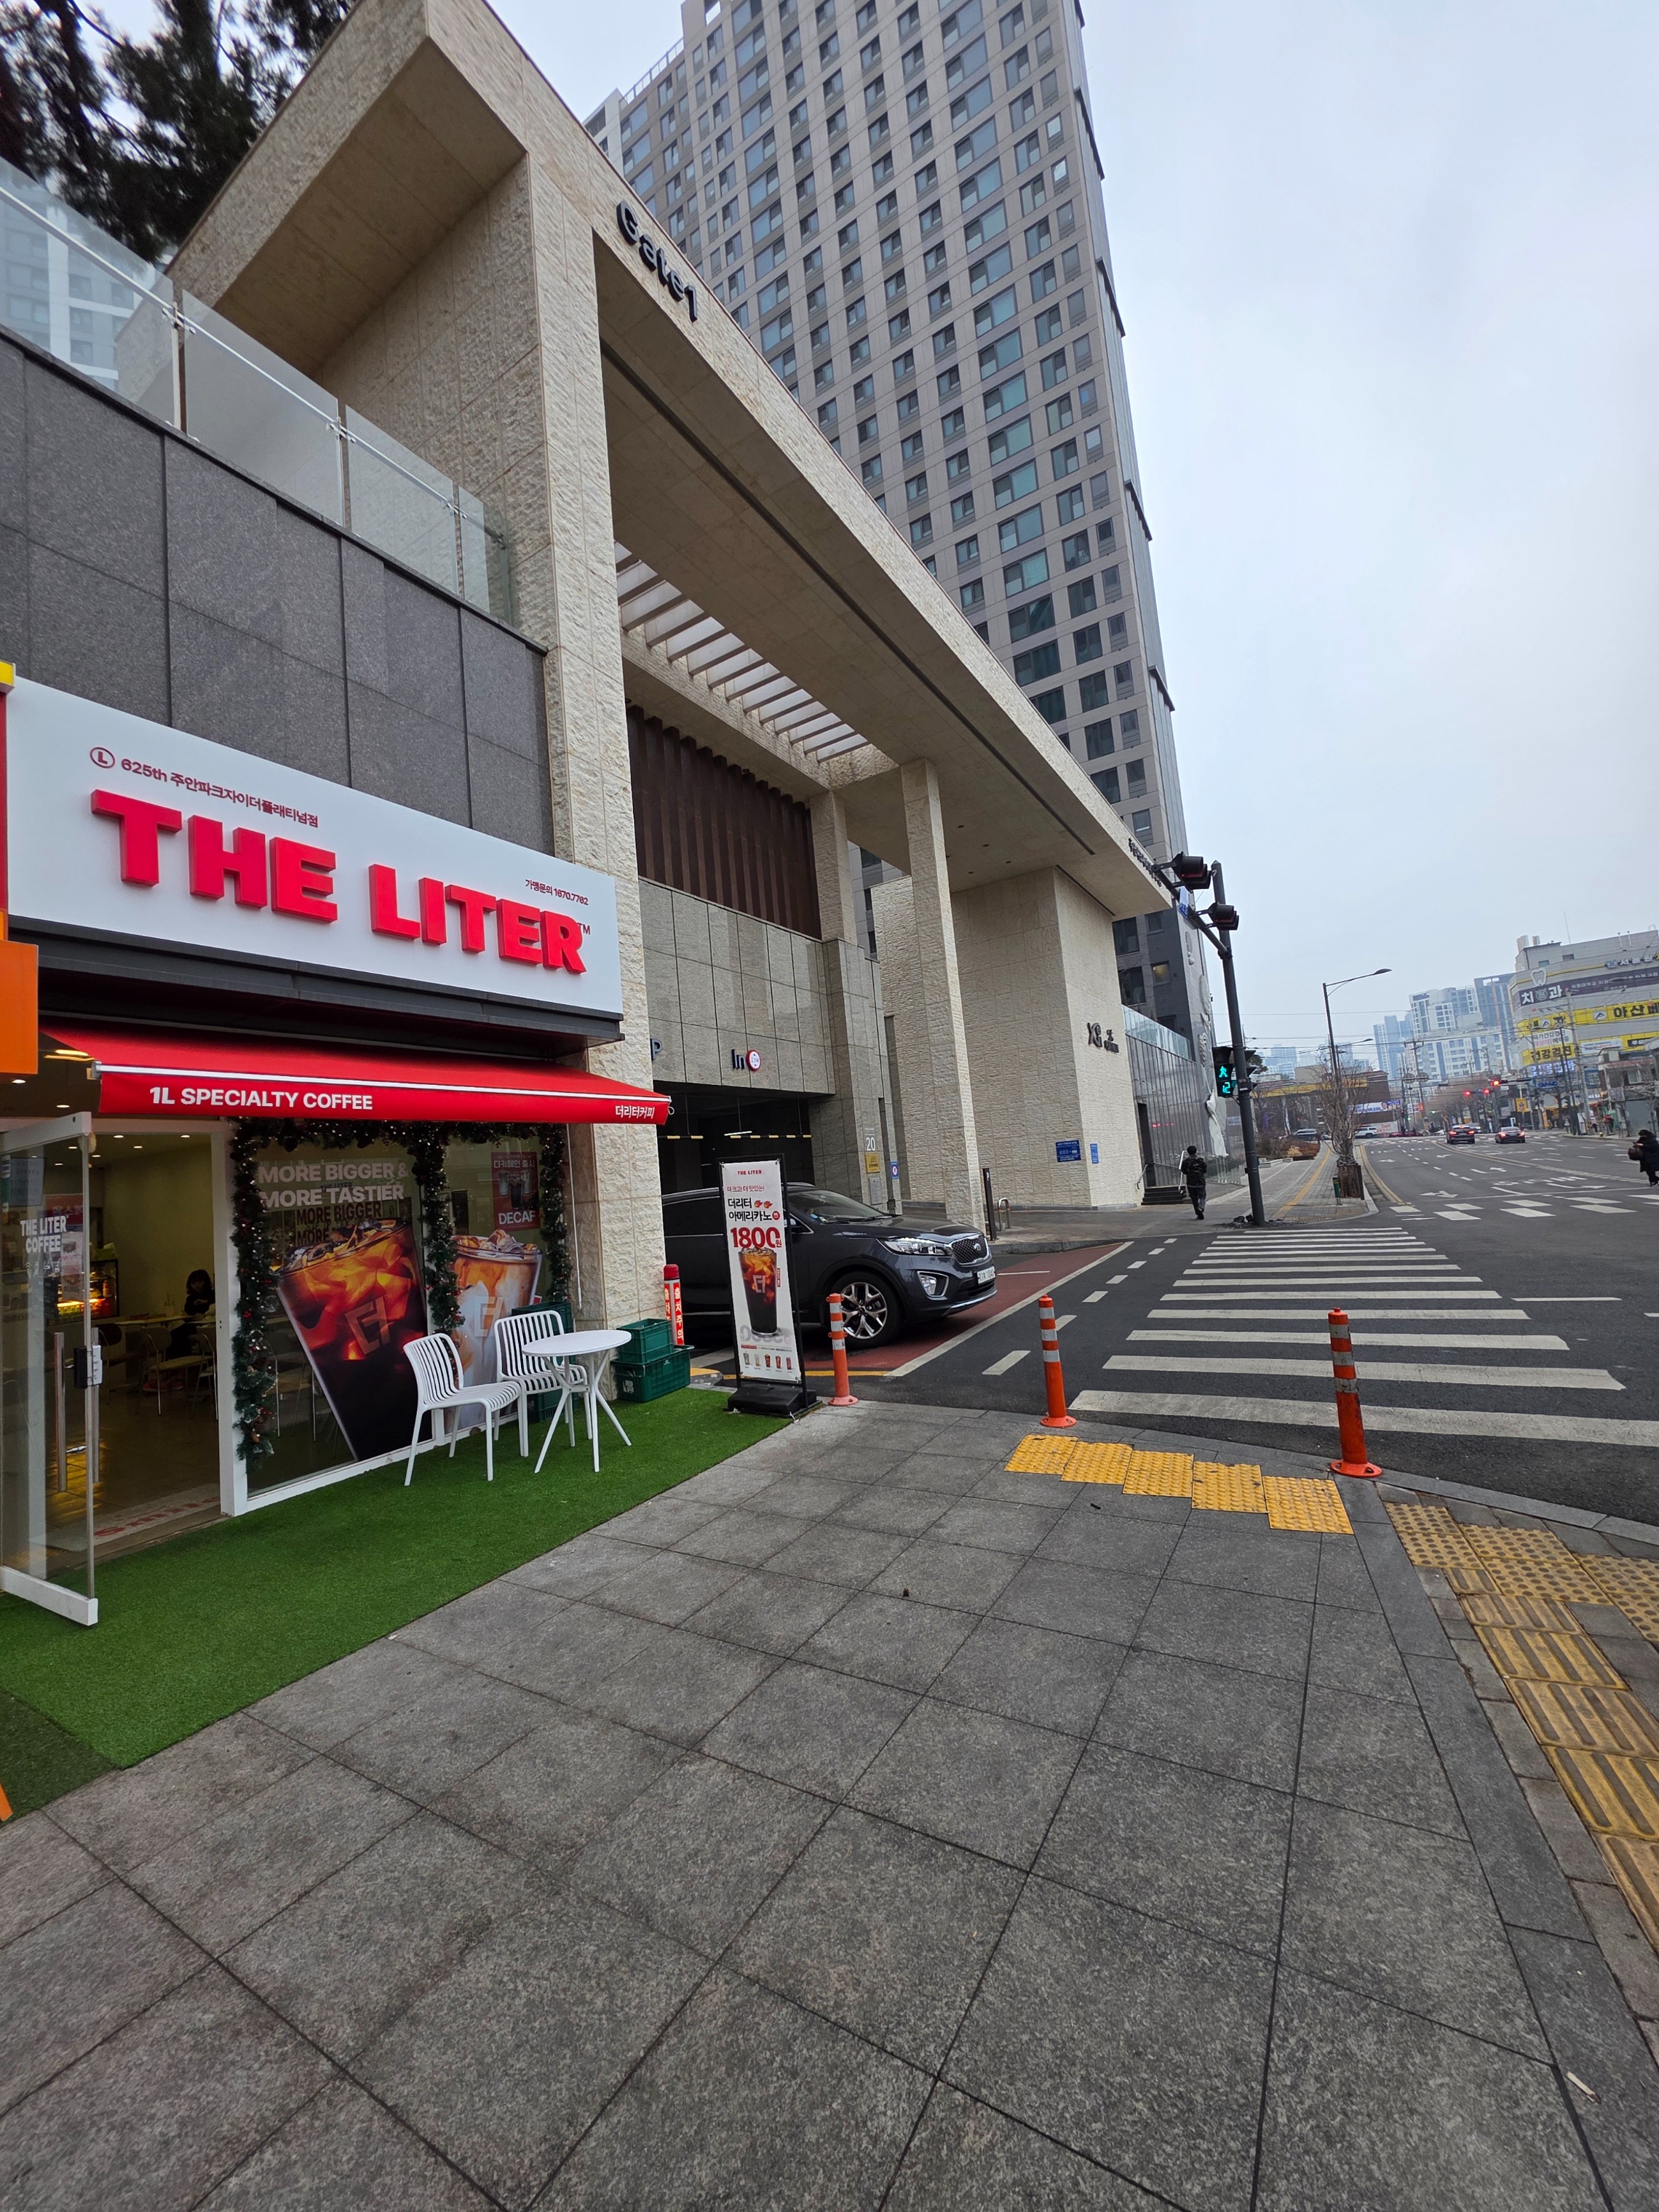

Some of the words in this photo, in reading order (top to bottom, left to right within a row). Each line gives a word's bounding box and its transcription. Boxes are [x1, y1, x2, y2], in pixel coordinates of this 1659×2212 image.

[121, 758, 167, 782] 625th
[170, 771, 319, 828] 주안파크자이더플래티넘점
[90, 789, 338, 923] THE
[368, 863, 587, 974] LITER
[525, 878, 553, 896] 가맹문의
[731, 1049, 746, 1070] In
[150, 1087, 175, 1105] 1L
[180, 1088, 299, 1107] SPECIALTY
[303, 1093, 373, 1110] COFFEE
[615, 1105, 656, 1119] 더리터커피
[865, 1137, 876, 1151] 20
[258, 1165, 322, 1184] MORE
[325, 1163, 395, 1180] BIGGER
[398, 1163, 410, 1177] &
[258, 1188, 322, 1209] MORE
[326, 1185, 405, 1204] TASTIER
[728, 1198, 752, 1209] 더리터
[334, 1201, 382, 1220] BIGGER
[498, 1211, 536, 1225] DECAF
[729, 1210, 773, 1222] 아메리카노
[20, 1219, 38, 1236] THE
[39, 1215, 67, 1234] LITER
[25, 1235, 61, 1254] COFFEE
